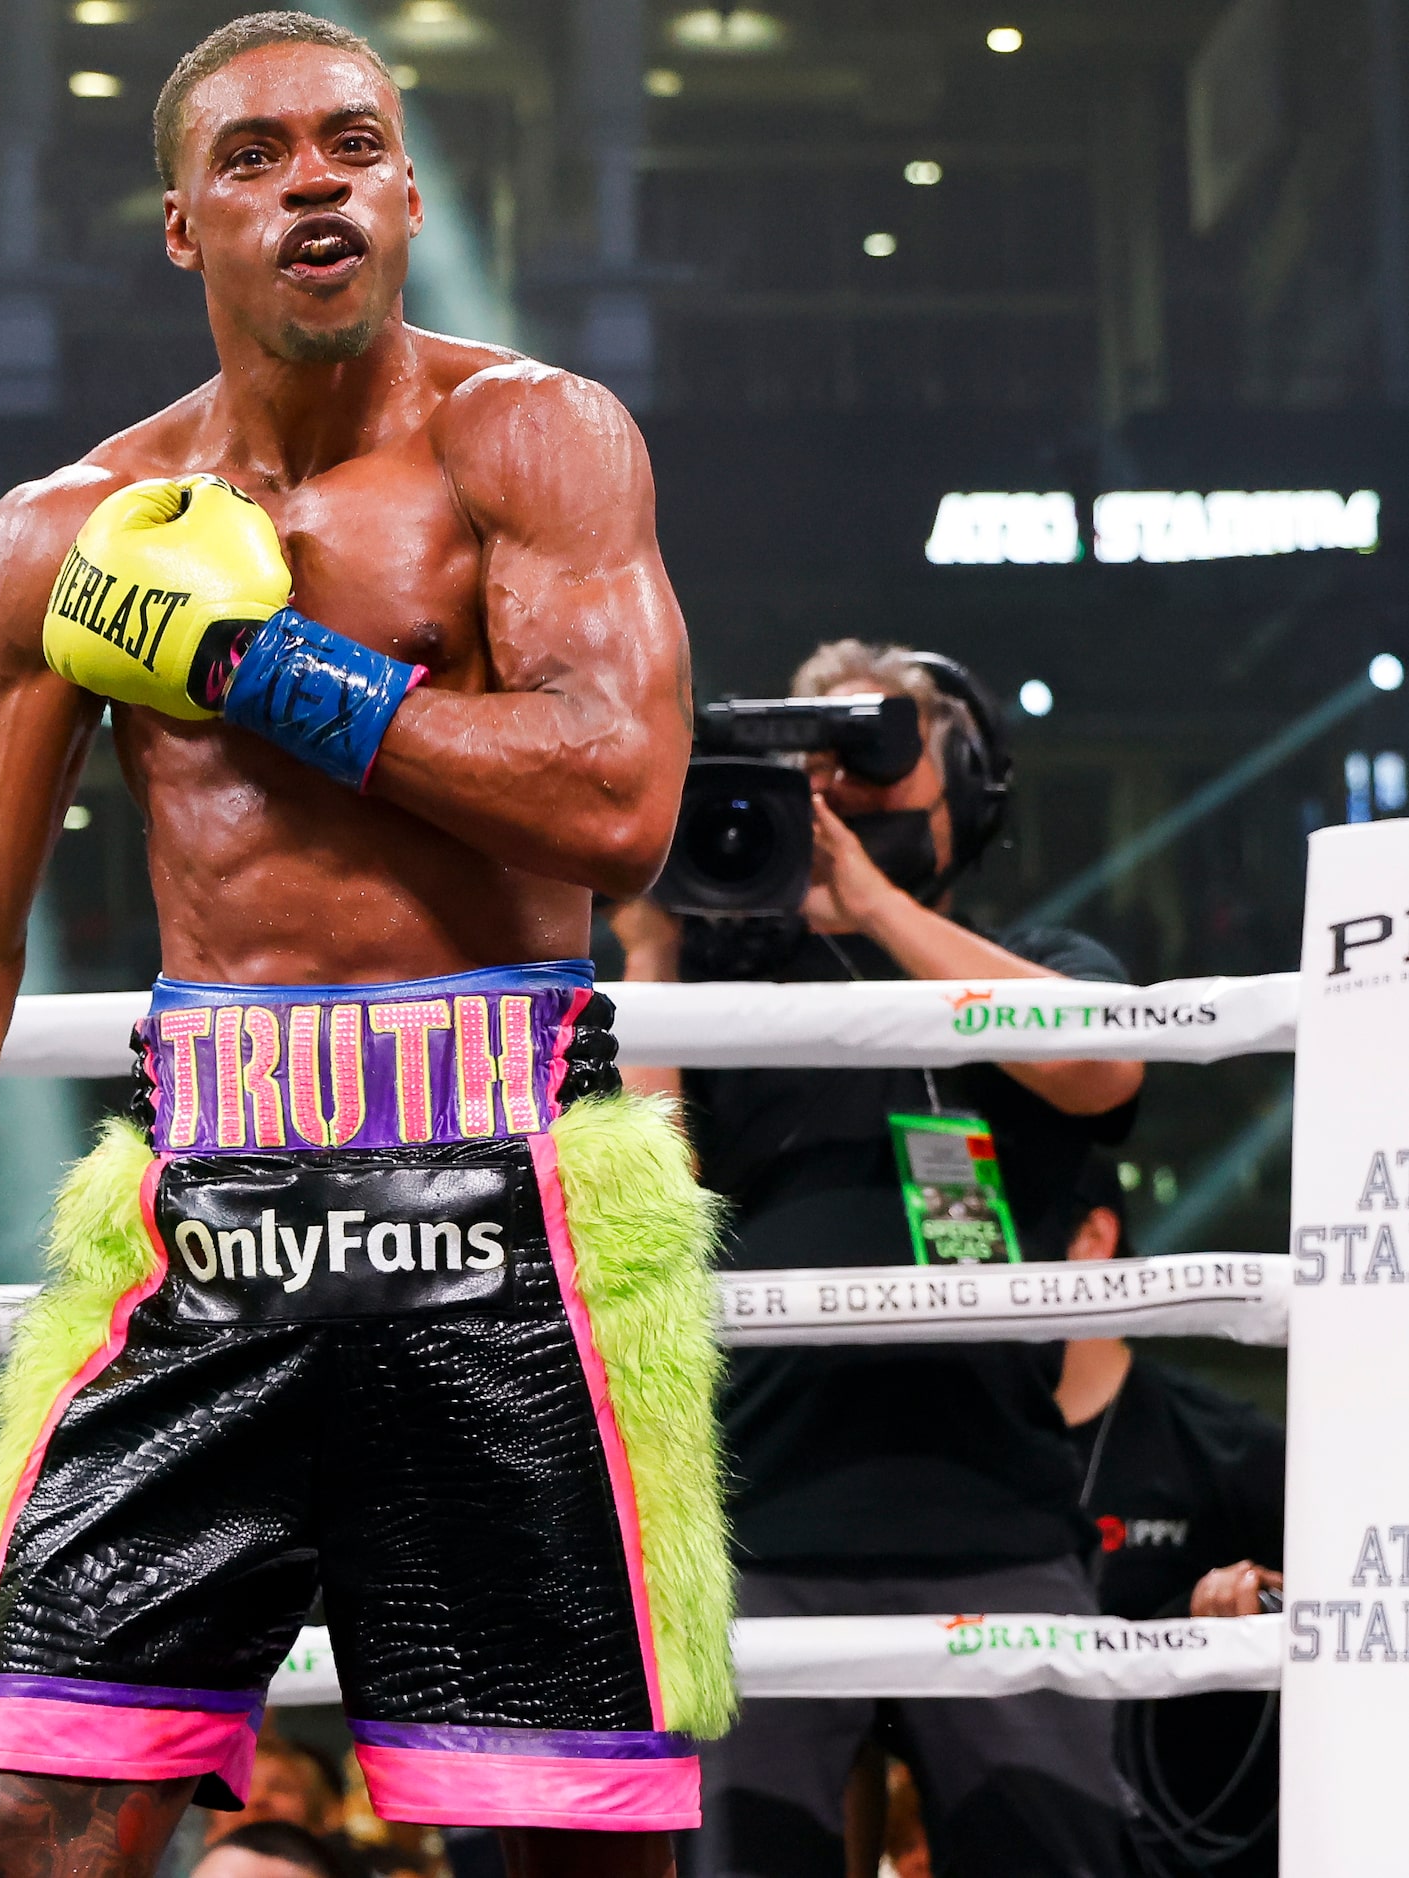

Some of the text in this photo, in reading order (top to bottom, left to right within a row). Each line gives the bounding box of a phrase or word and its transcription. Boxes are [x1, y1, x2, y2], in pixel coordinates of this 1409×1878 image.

[51, 545, 192, 673] VERLAST
[952, 1001, 1218, 1036] DRAFTKINGS
[160, 994, 541, 1149] TRUTH
[175, 1208, 505, 1294] OnlyFans
[818, 1280, 981, 1313] BOXING
[1009, 1262, 1265, 1306] CHAMPIONS
[948, 1622, 1209, 1657] DRAFTKINGS
